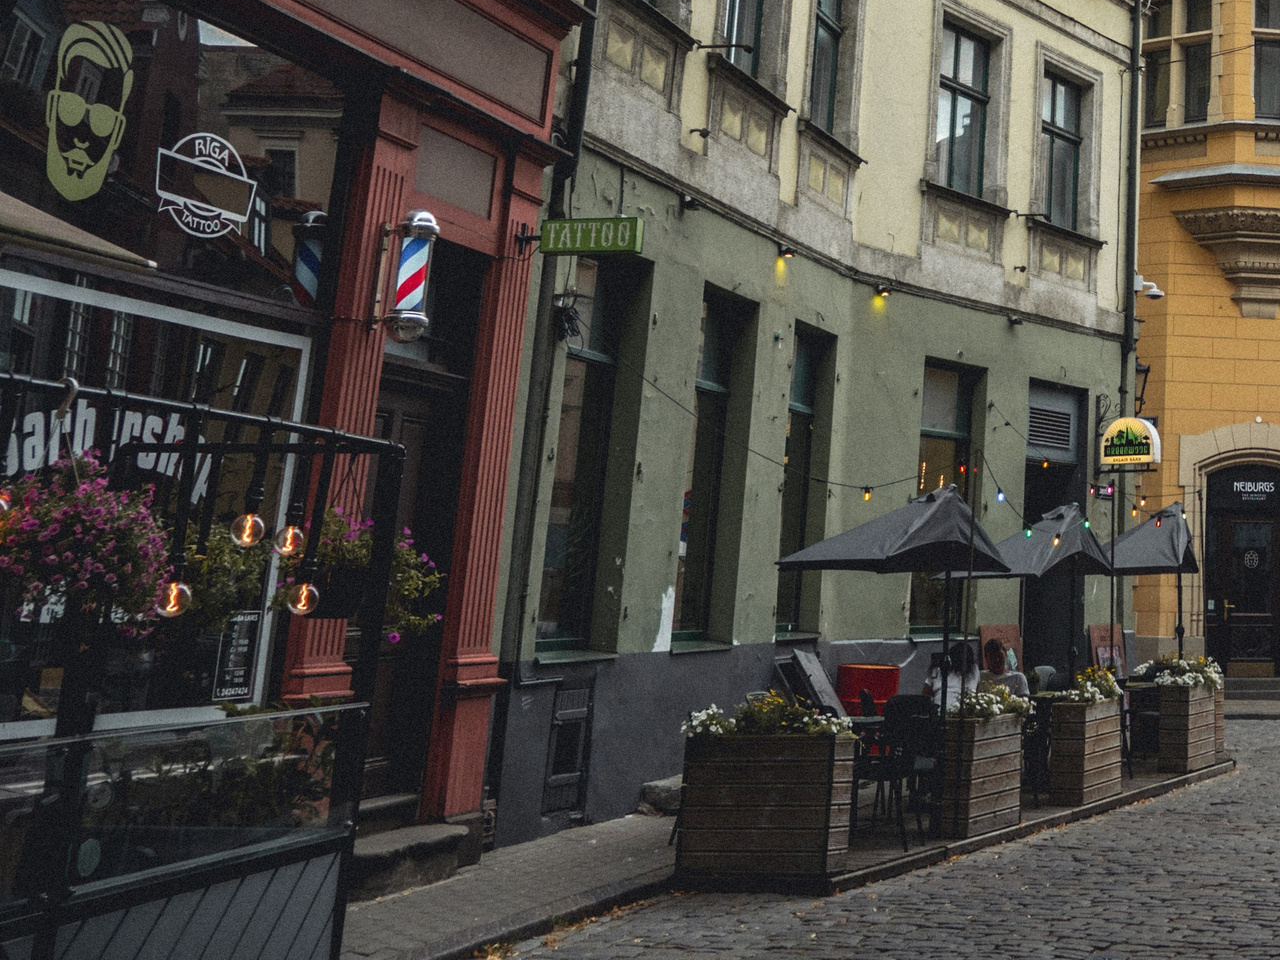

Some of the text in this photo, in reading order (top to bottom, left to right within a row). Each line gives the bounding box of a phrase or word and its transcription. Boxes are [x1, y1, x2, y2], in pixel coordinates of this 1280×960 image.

[181, 208, 220, 233] TATTOO
[547, 221, 631, 249] TATTOO
[1233, 481, 1275, 492] NEIBURGS
